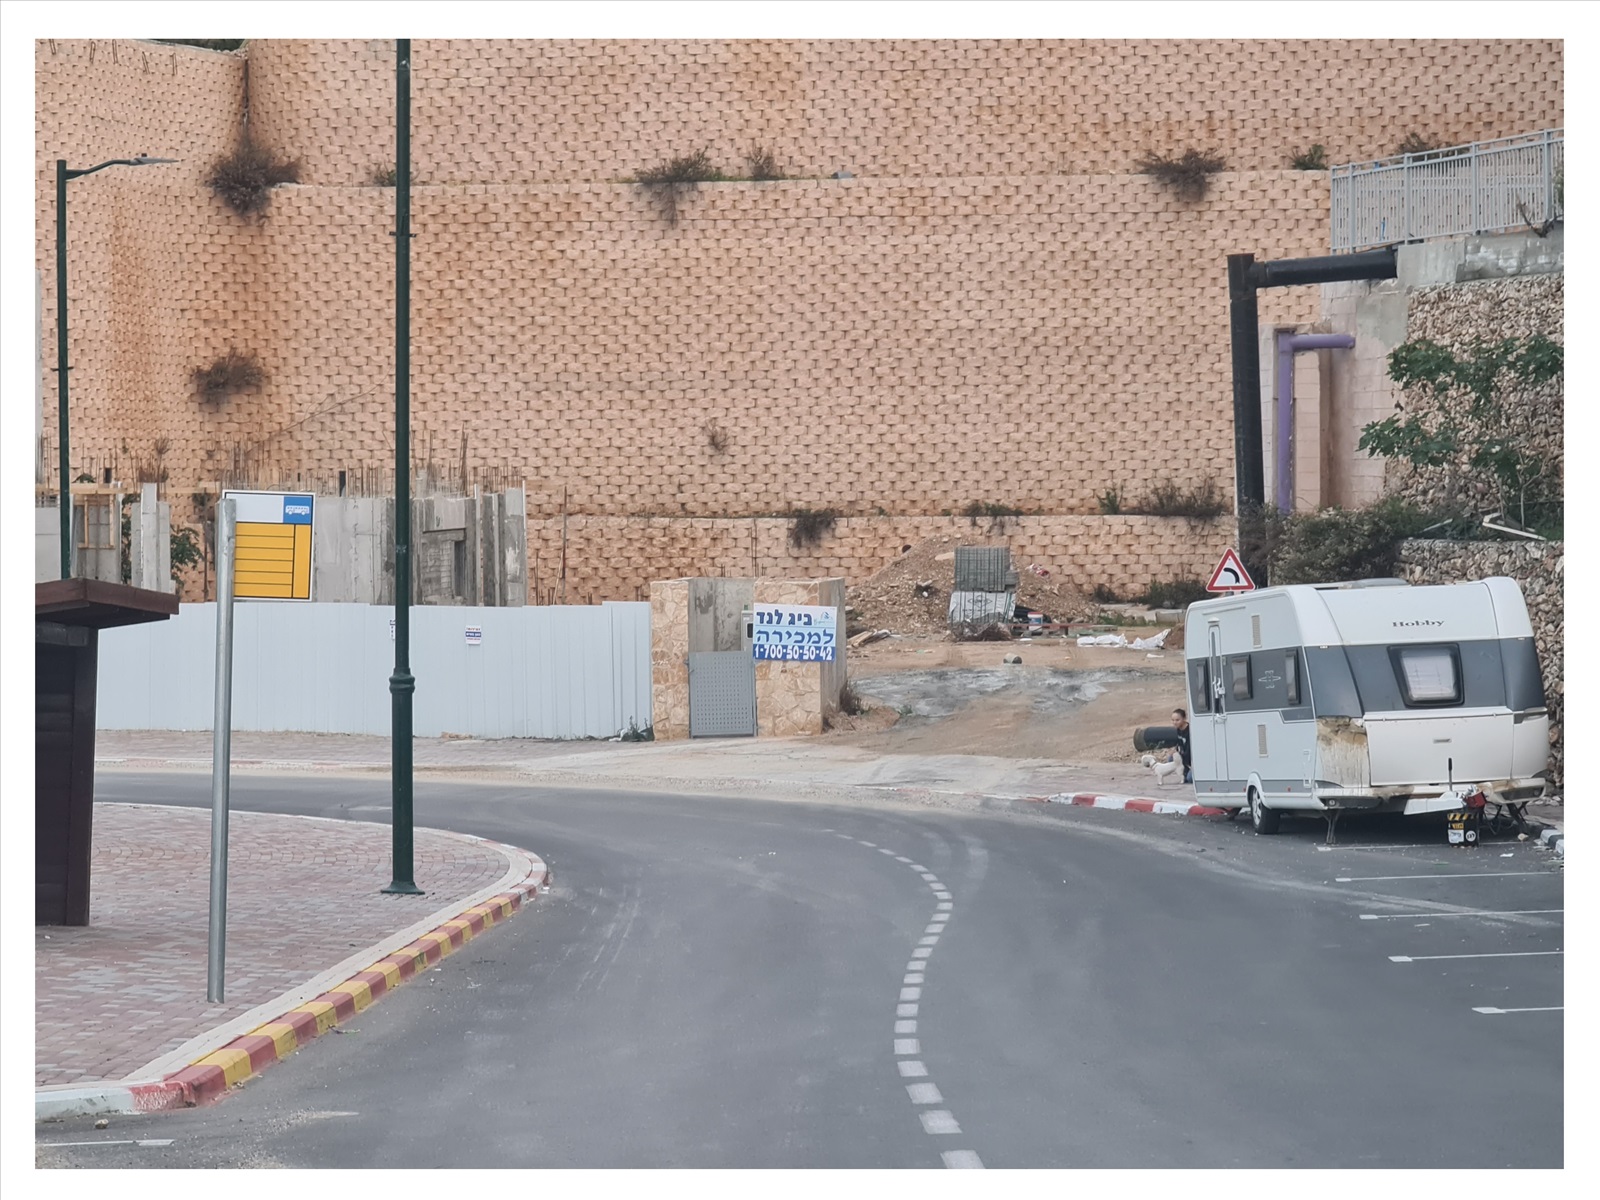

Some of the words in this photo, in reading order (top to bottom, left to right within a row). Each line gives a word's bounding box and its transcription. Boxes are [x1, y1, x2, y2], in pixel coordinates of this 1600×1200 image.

[756, 608, 783, 626] לנד
[788, 612, 813, 626] ביג
[1392, 619, 1445, 627] Hobby
[755, 628, 834, 645] למכירה
